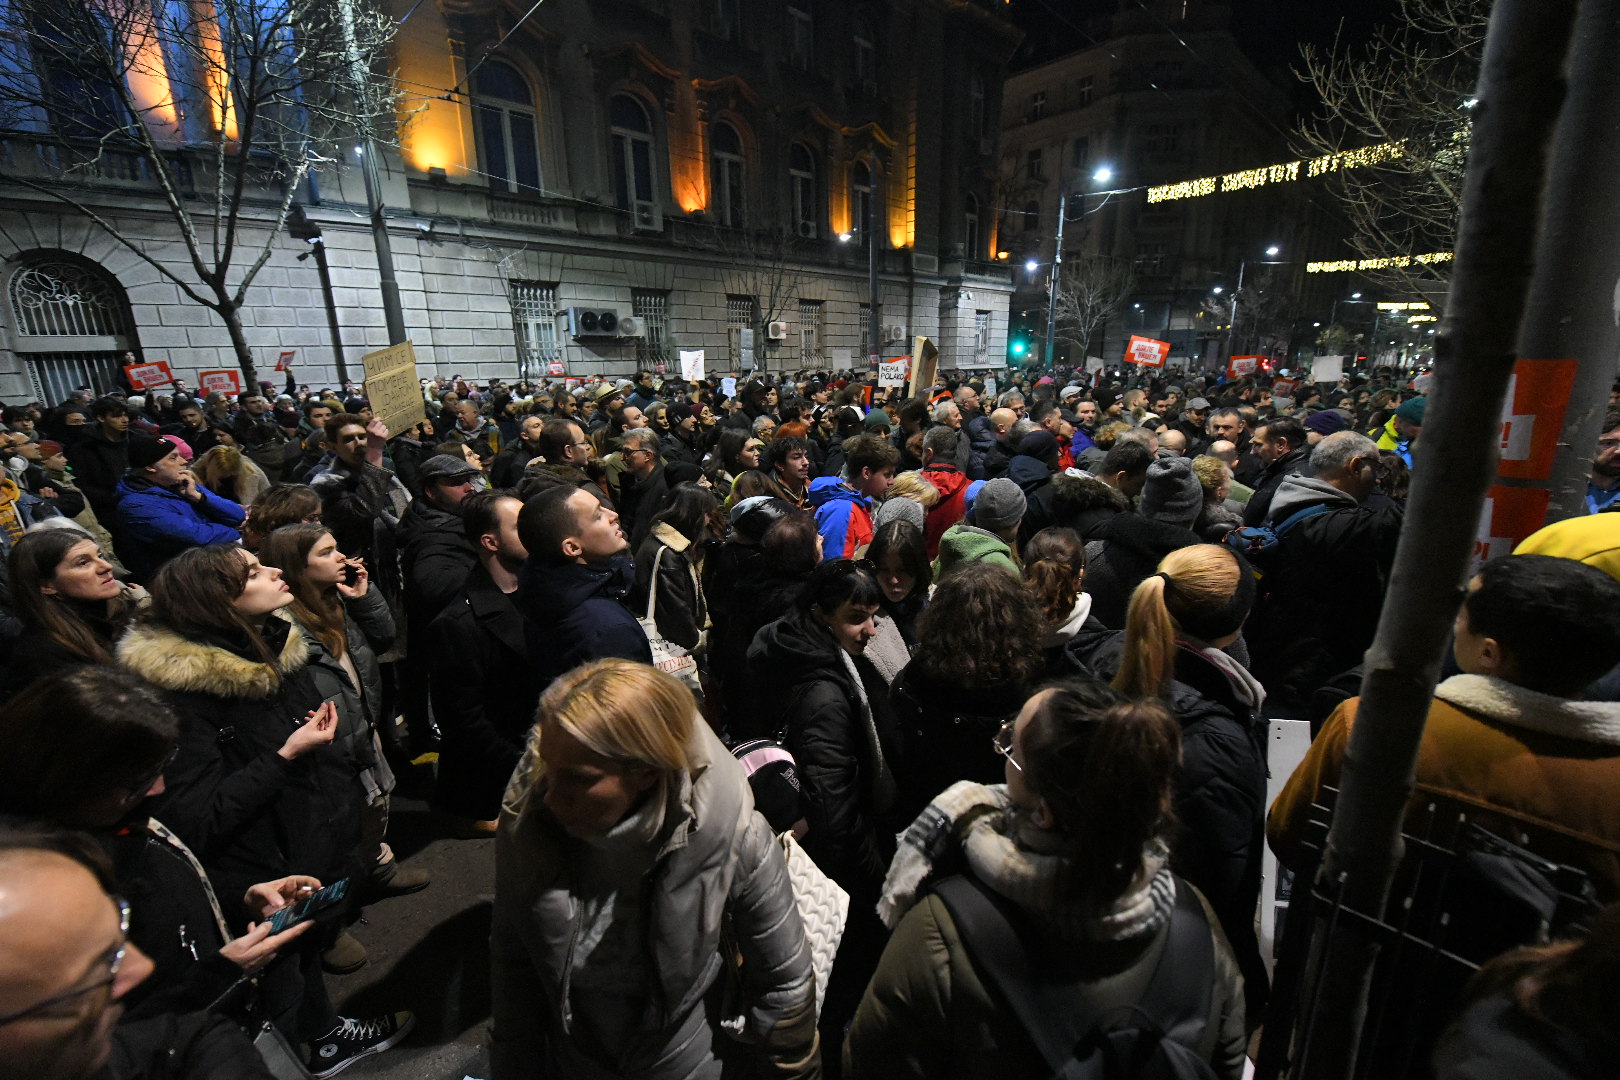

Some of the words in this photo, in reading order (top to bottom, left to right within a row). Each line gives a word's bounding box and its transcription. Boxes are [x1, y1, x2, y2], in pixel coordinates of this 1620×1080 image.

[366, 354, 394, 372] ЧИМ
[395, 349, 407, 365] СЕ
[881, 365, 899, 373] NEMA
